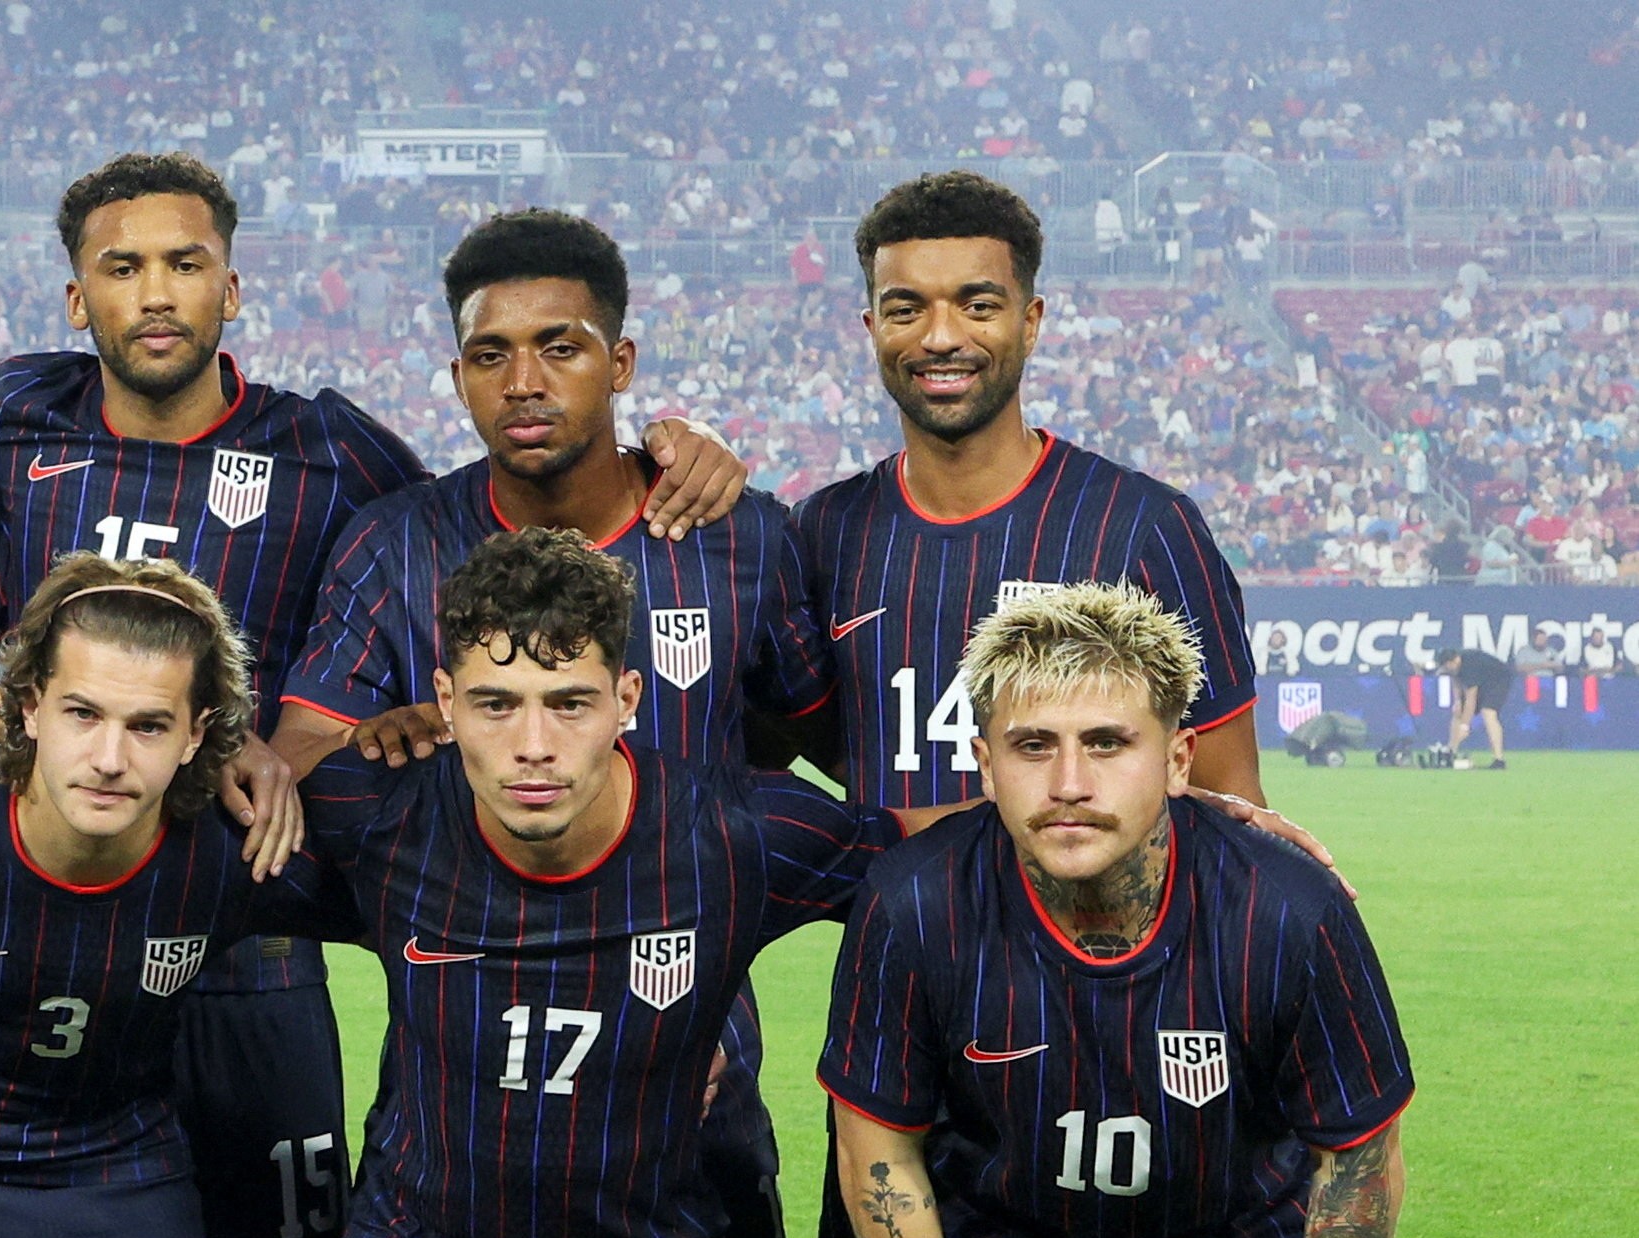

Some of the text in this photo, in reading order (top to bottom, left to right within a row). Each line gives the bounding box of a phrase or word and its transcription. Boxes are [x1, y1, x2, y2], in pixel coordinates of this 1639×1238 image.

[217, 453, 269, 485] USA
[655, 613, 706, 643] USA
[1245, 612, 1443, 668] pact
[1282, 686, 1318, 708] USA
[890, 667, 980, 772] 14
[148, 938, 204, 966] USA
[635, 935, 692, 967] USA
[30, 995, 91, 1059] 3
[498, 1004, 603, 1096] 17
[1162, 1036, 1223, 1066] USA
[1055, 1109, 1152, 1197] 10
